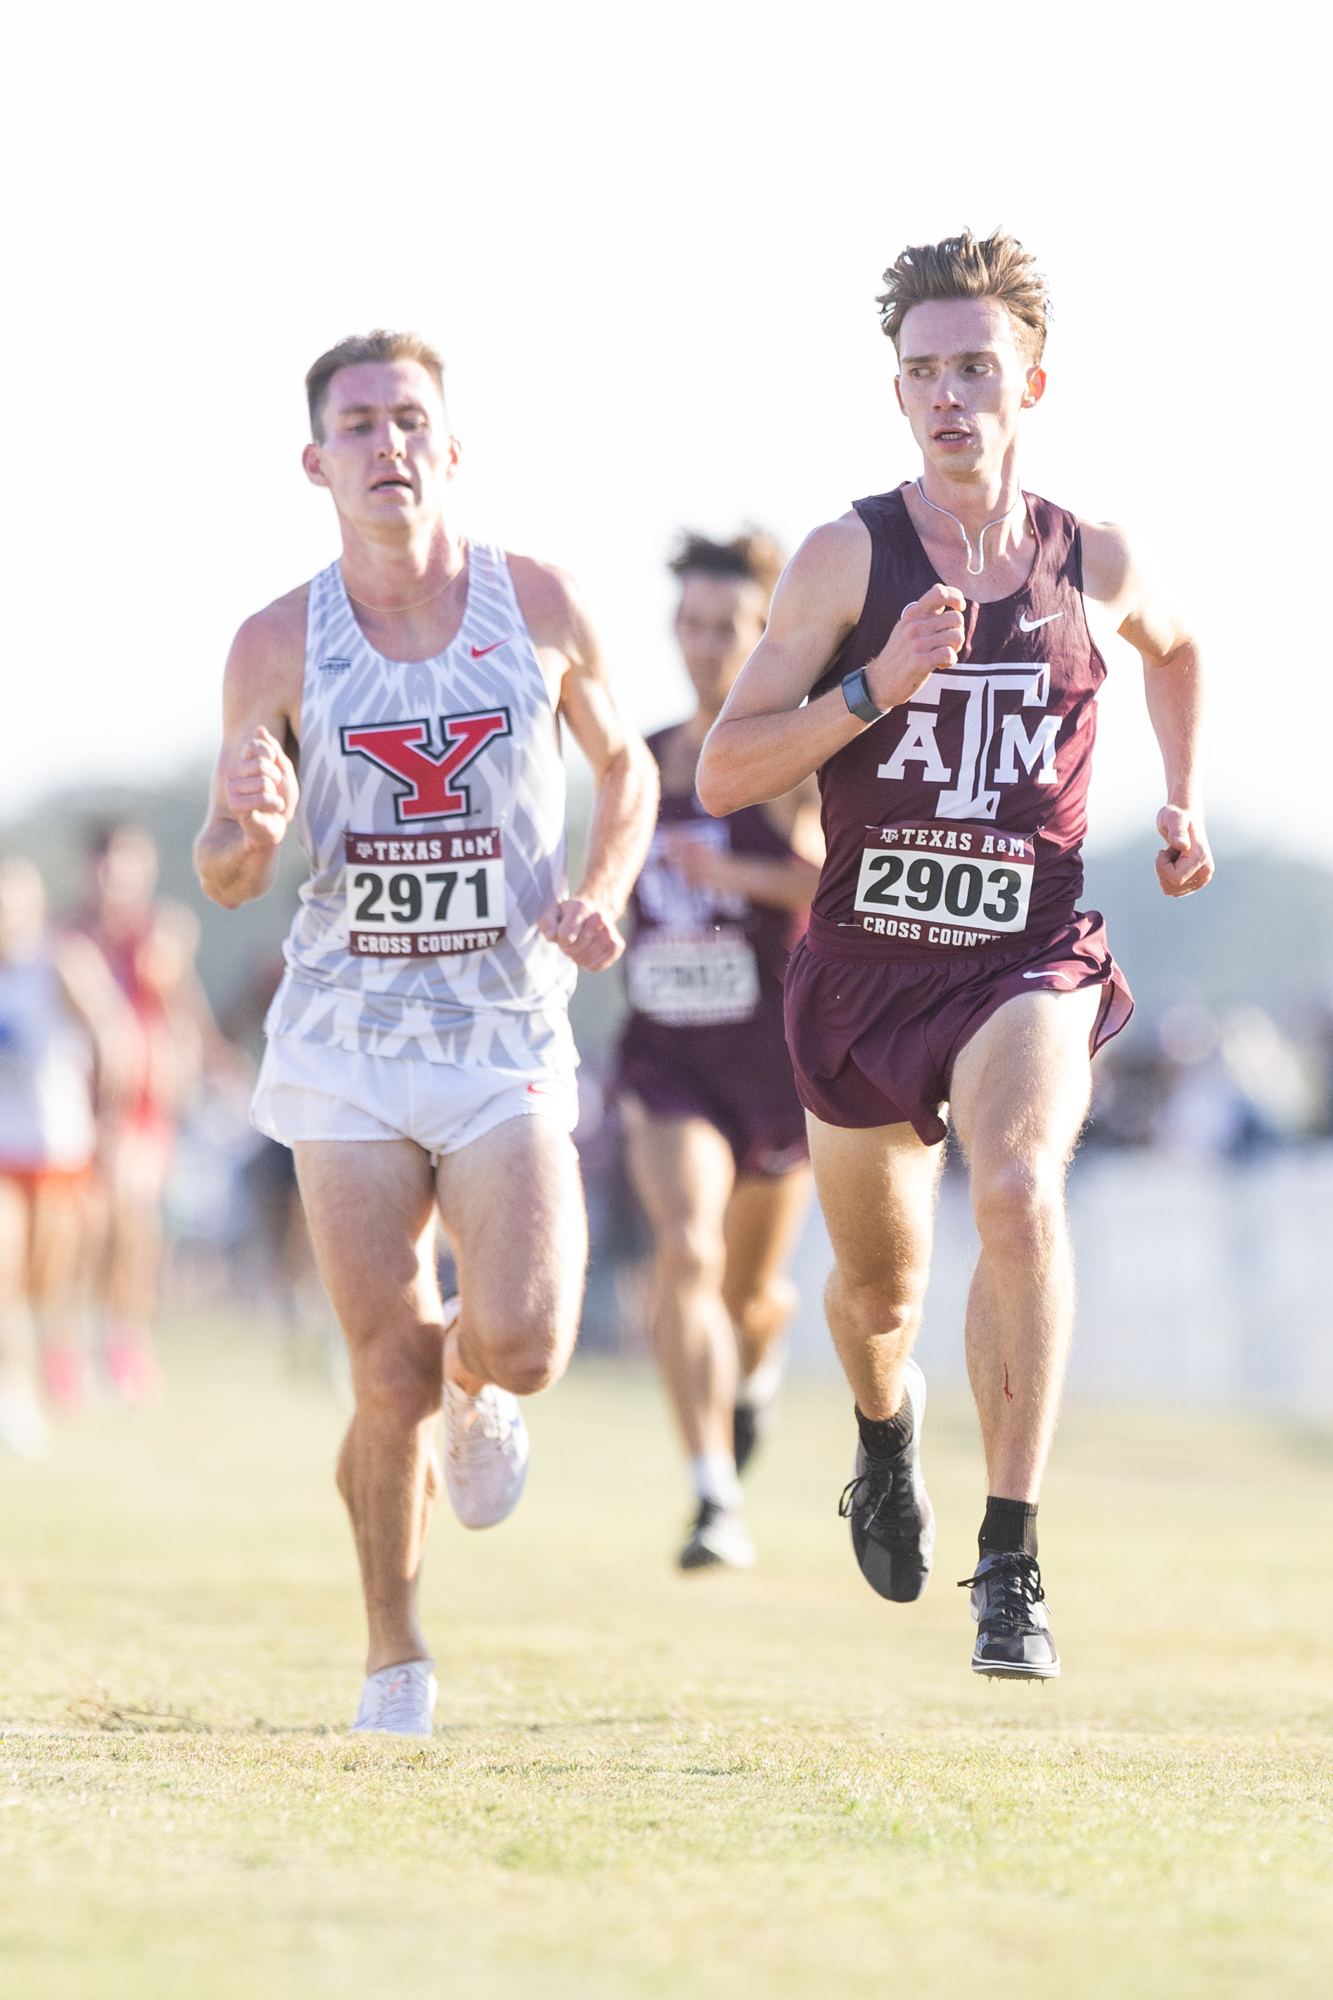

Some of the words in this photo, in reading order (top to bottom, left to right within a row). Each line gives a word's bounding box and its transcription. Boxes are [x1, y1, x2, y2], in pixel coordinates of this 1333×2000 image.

[340, 706, 512, 825] Y
[373, 840, 442, 861] TEXAS
[451, 835, 494, 858] A&M
[902, 828, 973, 851] TEXAS
[981, 835, 1025, 858] A&M
[354, 868, 489, 923] 2971
[863, 855, 1022, 923] 2903
[357, 935, 412, 954] CROSS
[417, 931, 499, 954] COUNTRY
[863, 916, 922, 941] CROSS
[928, 926, 1008, 947] COUNT
